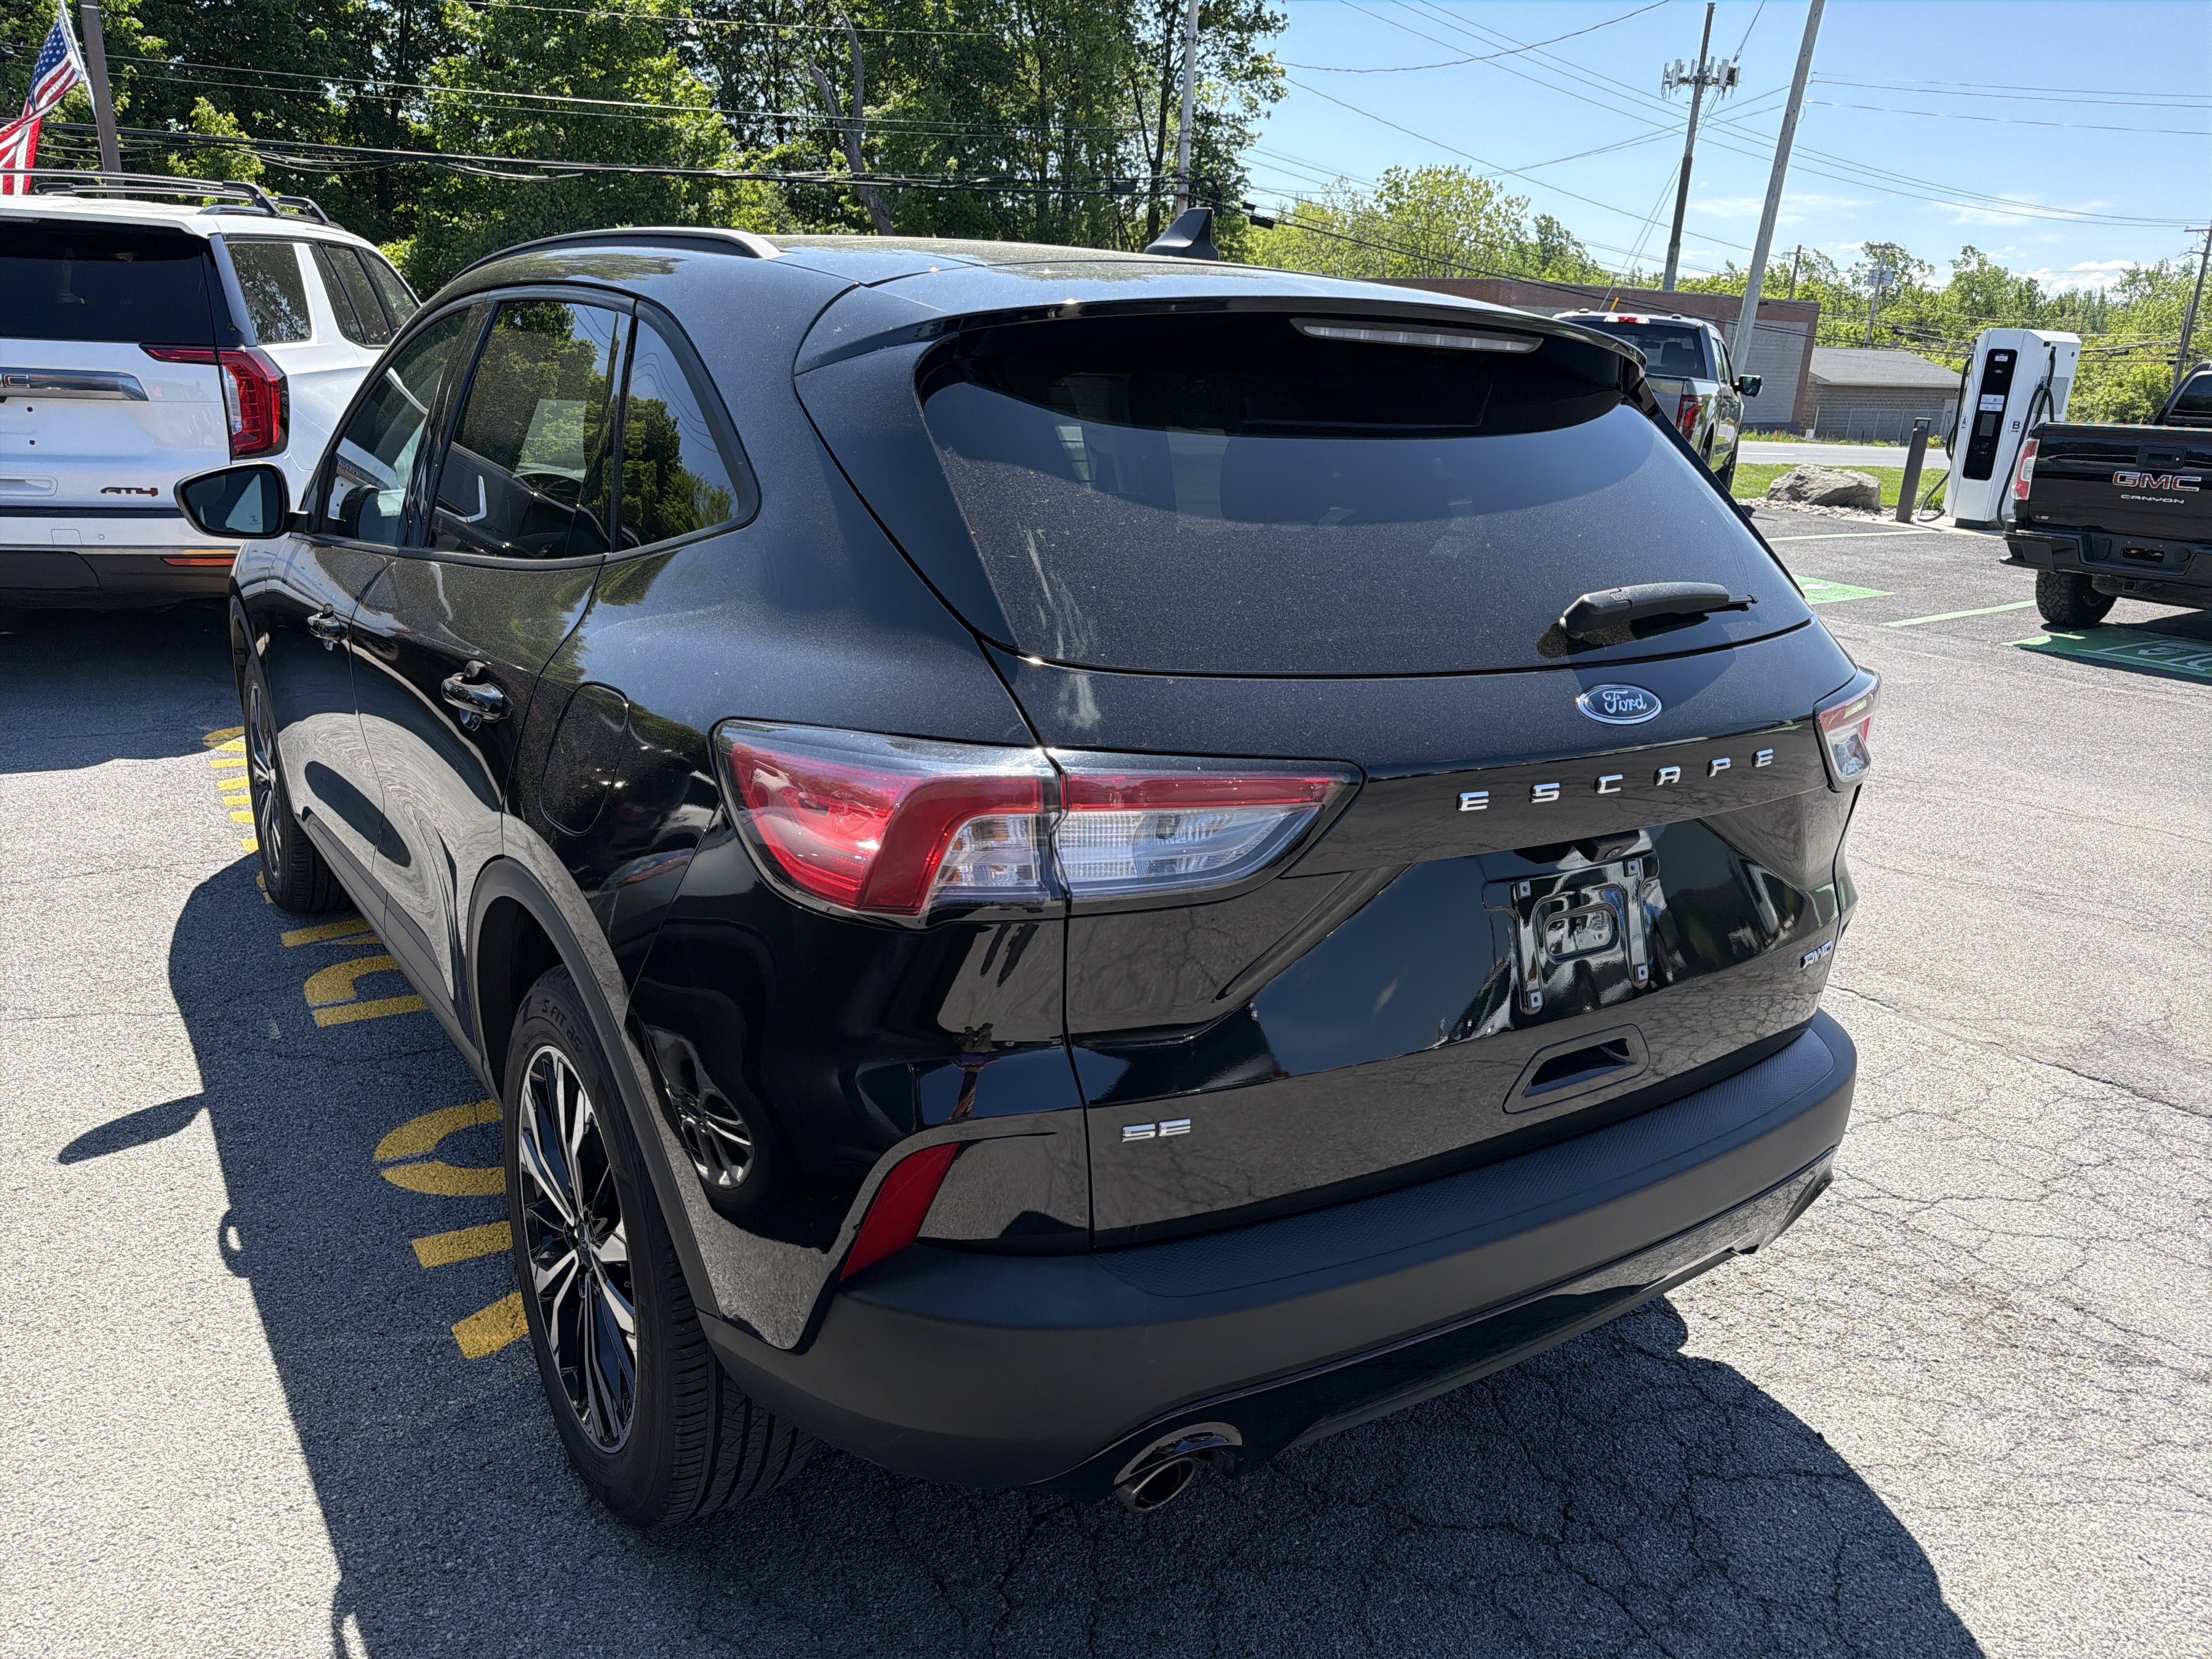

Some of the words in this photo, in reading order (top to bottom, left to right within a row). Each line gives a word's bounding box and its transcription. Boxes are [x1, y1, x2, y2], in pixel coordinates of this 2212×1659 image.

[1961, 417, 1966, 426] A
[2012, 421, 2021, 429] B
[100, 487, 159, 497] AT4
[2113, 471, 2202, 492] GMC
[2120, 494, 2185, 504] CANYON
[1602, 690, 1647, 714] Ford
[1457, 748, 1774, 812] ESCAPE
[1802, 940, 1832, 969] AWD
[550, 1005, 567, 1028] FIT
[1122, 1118, 1191, 1143] SE
